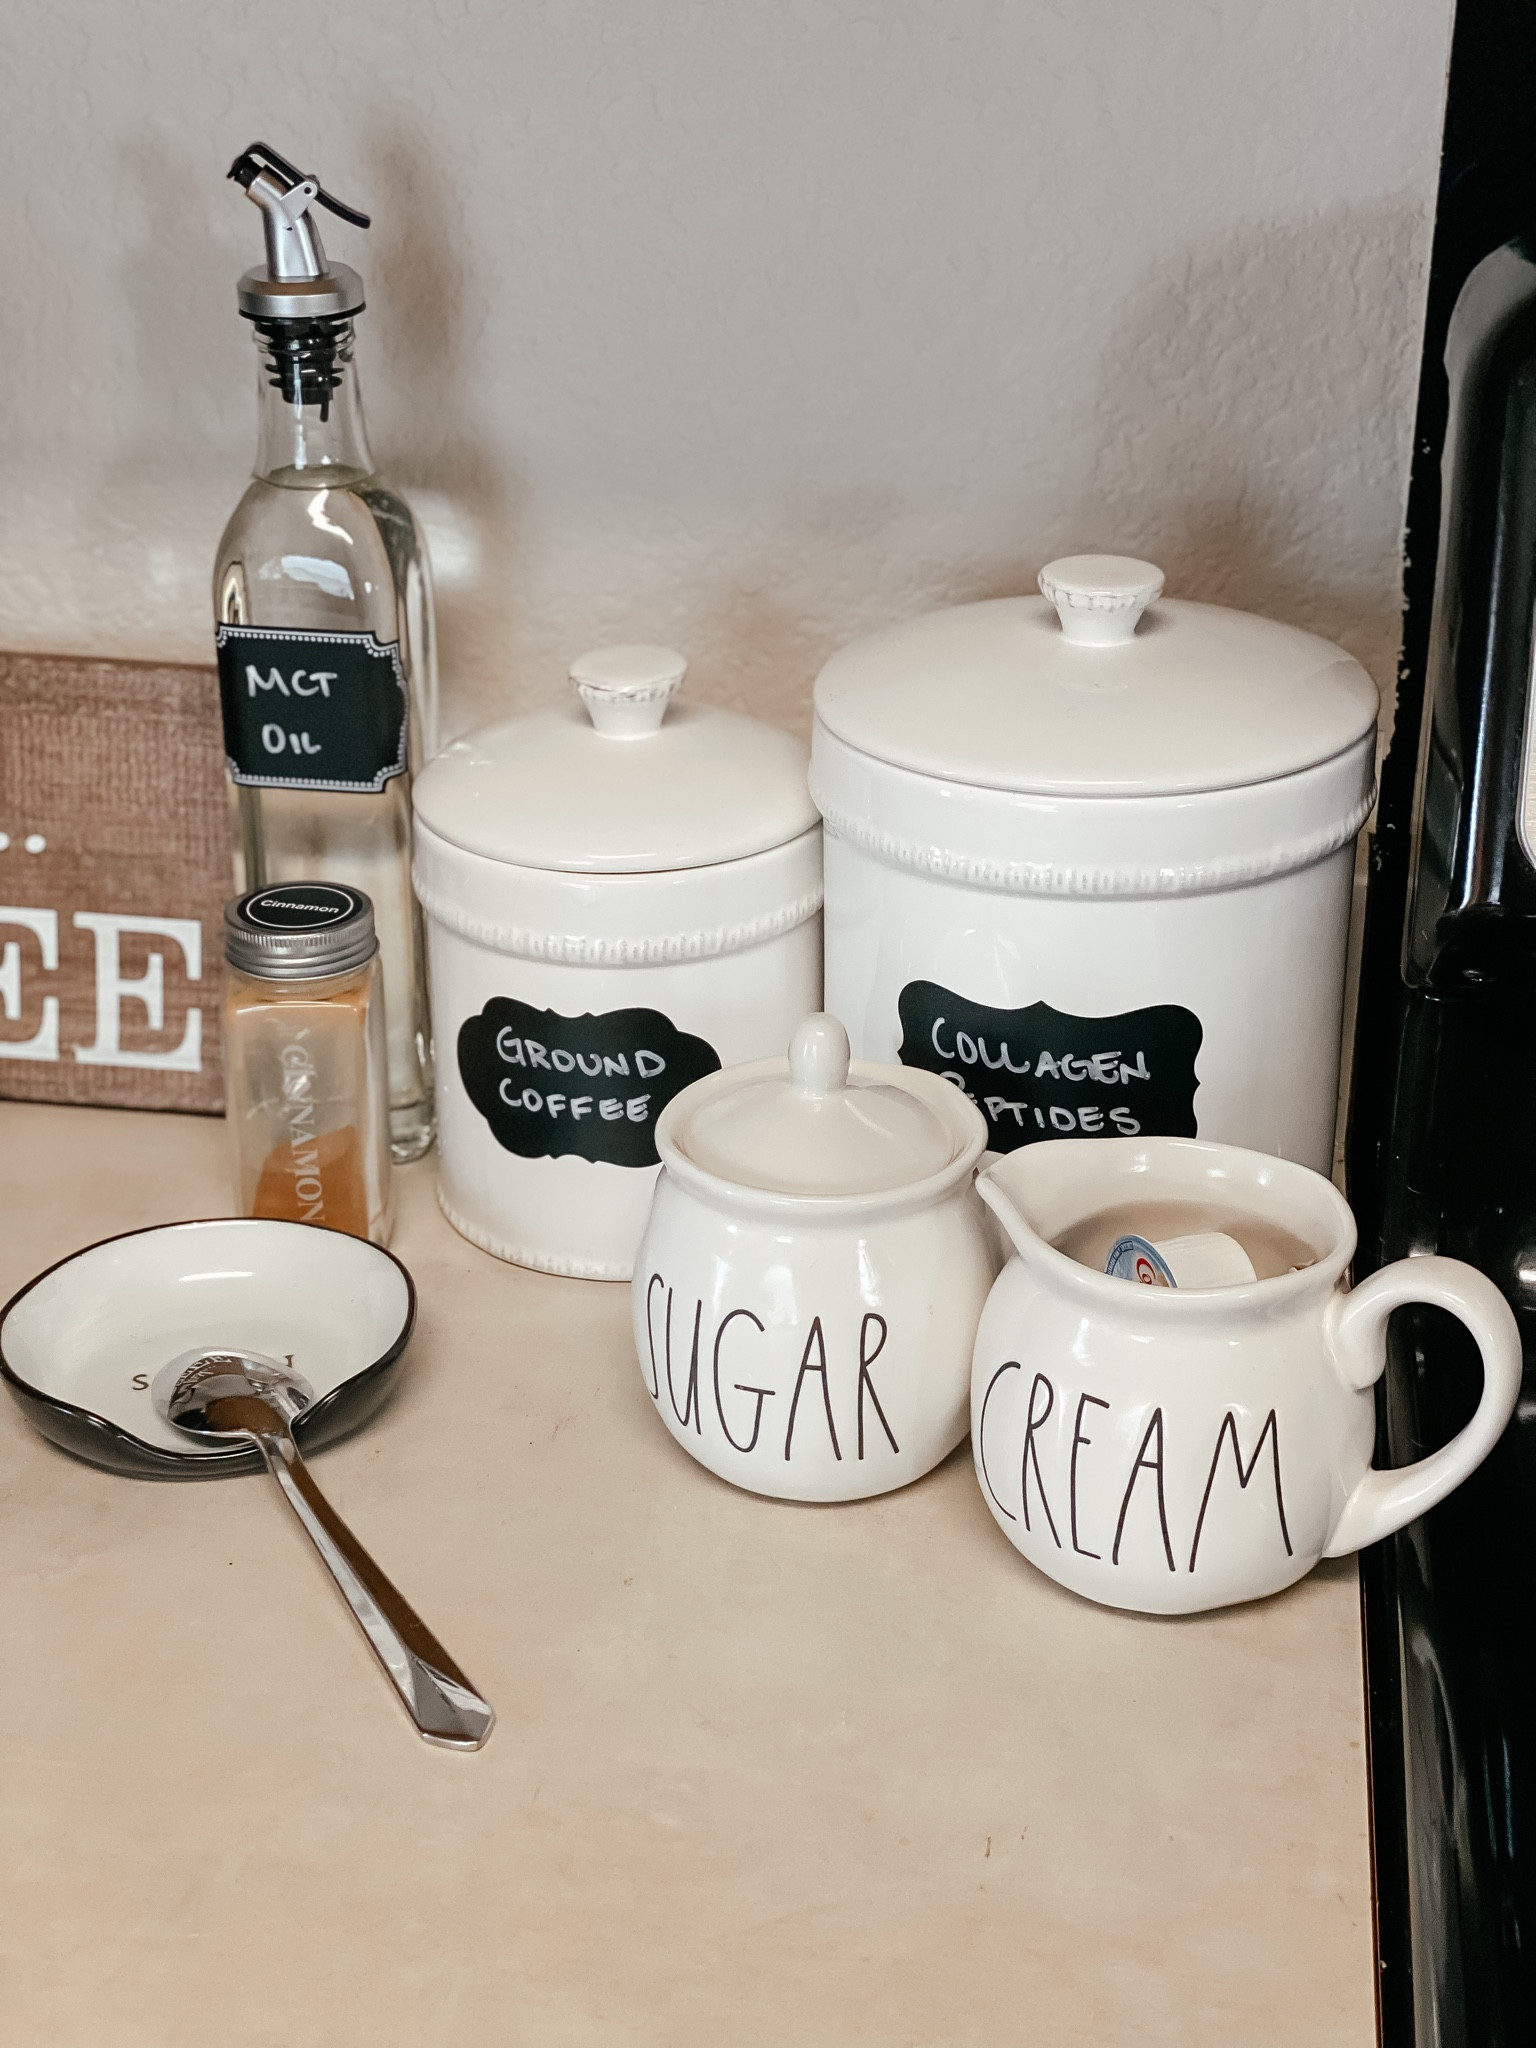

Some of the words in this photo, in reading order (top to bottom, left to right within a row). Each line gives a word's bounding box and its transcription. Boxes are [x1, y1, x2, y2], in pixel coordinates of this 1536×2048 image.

[245, 664, 338, 698] MCT
[261, 723, 322, 755] OIL
[260, 899, 340, 914] Cinnamon
[496, 1025, 666, 1078] GROUND
[931, 1017, 1151, 1085] COLLAGEN
[499, 1077, 651, 1122] COFFEE
[939, 1071, 1141, 1136] PTIDES
[647, 1273, 900, 1461] SUGAR
[980, 1361, 1293, 1573] CREAM
